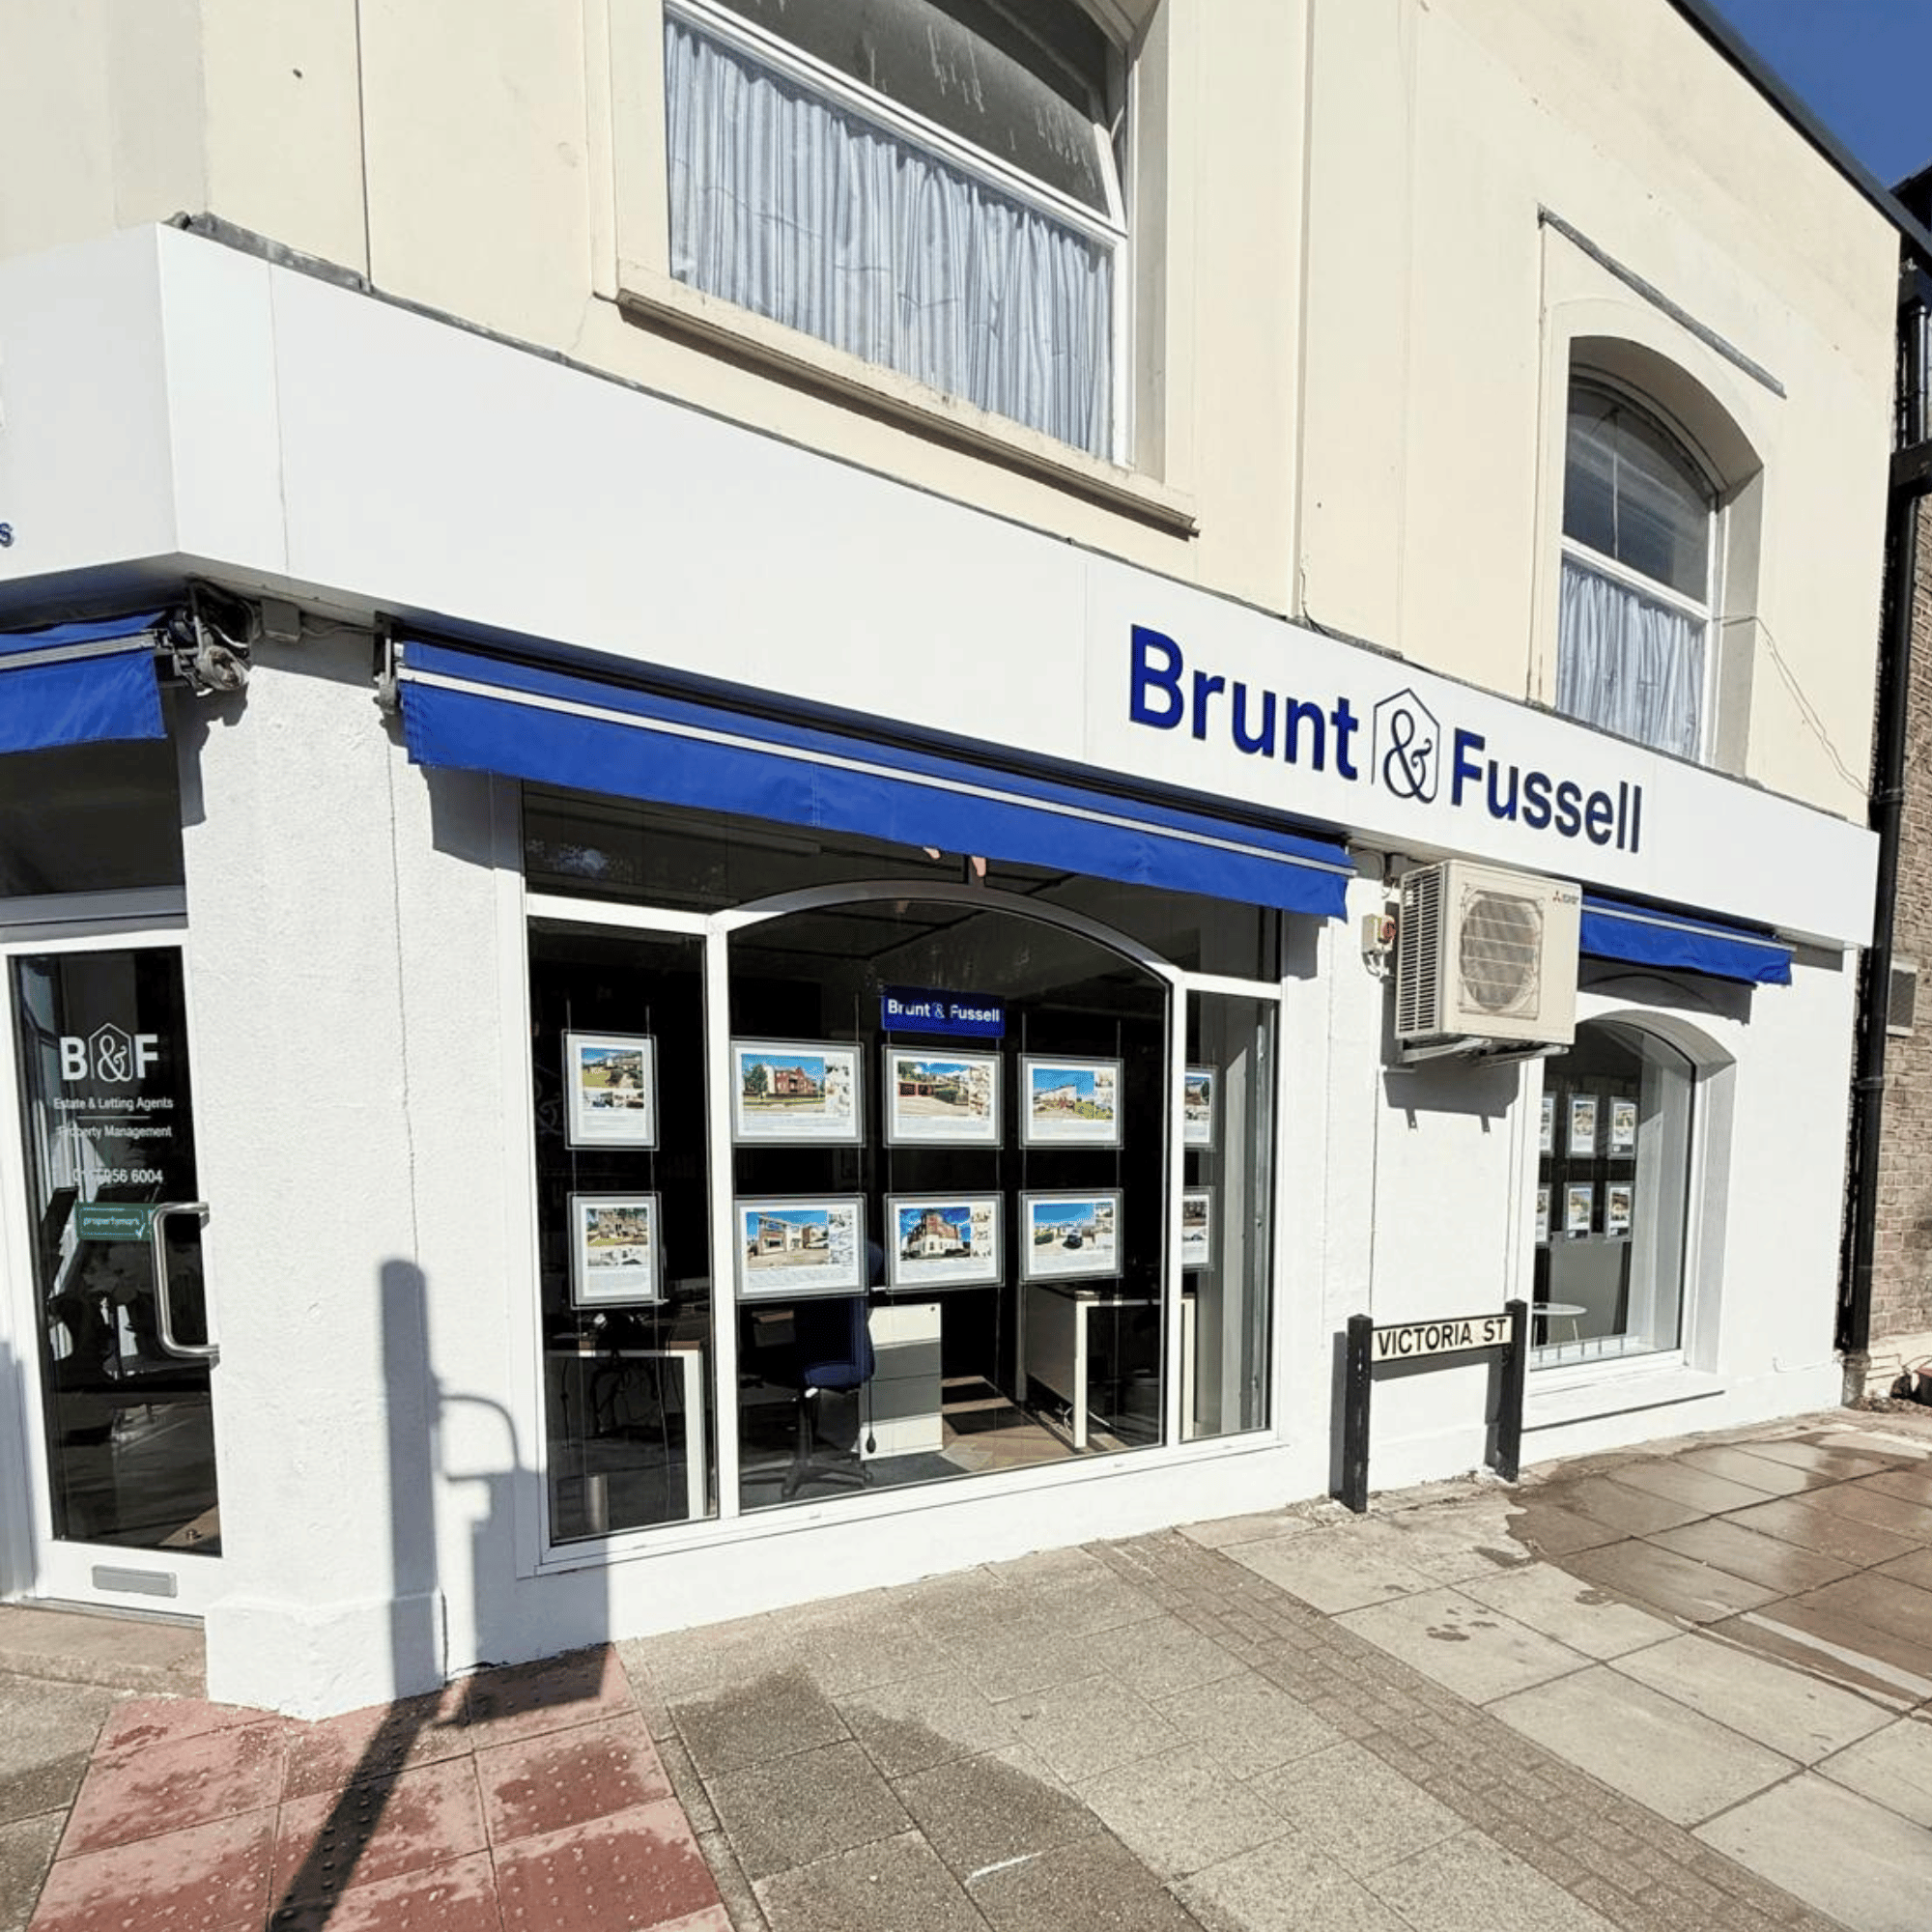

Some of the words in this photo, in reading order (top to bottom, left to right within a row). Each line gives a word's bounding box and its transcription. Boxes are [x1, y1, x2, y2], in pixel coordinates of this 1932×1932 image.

[1130, 624, 1359, 781] Brunt
[1382, 709, 1435, 804] &
[1451, 727, 1643, 854] Fussell
[888, 999, 930, 1017] Brunt
[932, 1003, 946, 1019] &
[952, 1005, 1000, 1022] Fussell
[53, 1097, 86, 1109] Estate
[88, 1097, 97, 1109] &
[98, 1097, 134, 1111] Letting
[136, 1096, 174, 1111] Agents
[103, 1124, 172, 1140] Management
[130, 1168, 163, 1183] 6004
[1378, 1321, 1473, 1356] VICTORIA
[1483, 1319, 1507, 1342] ST
